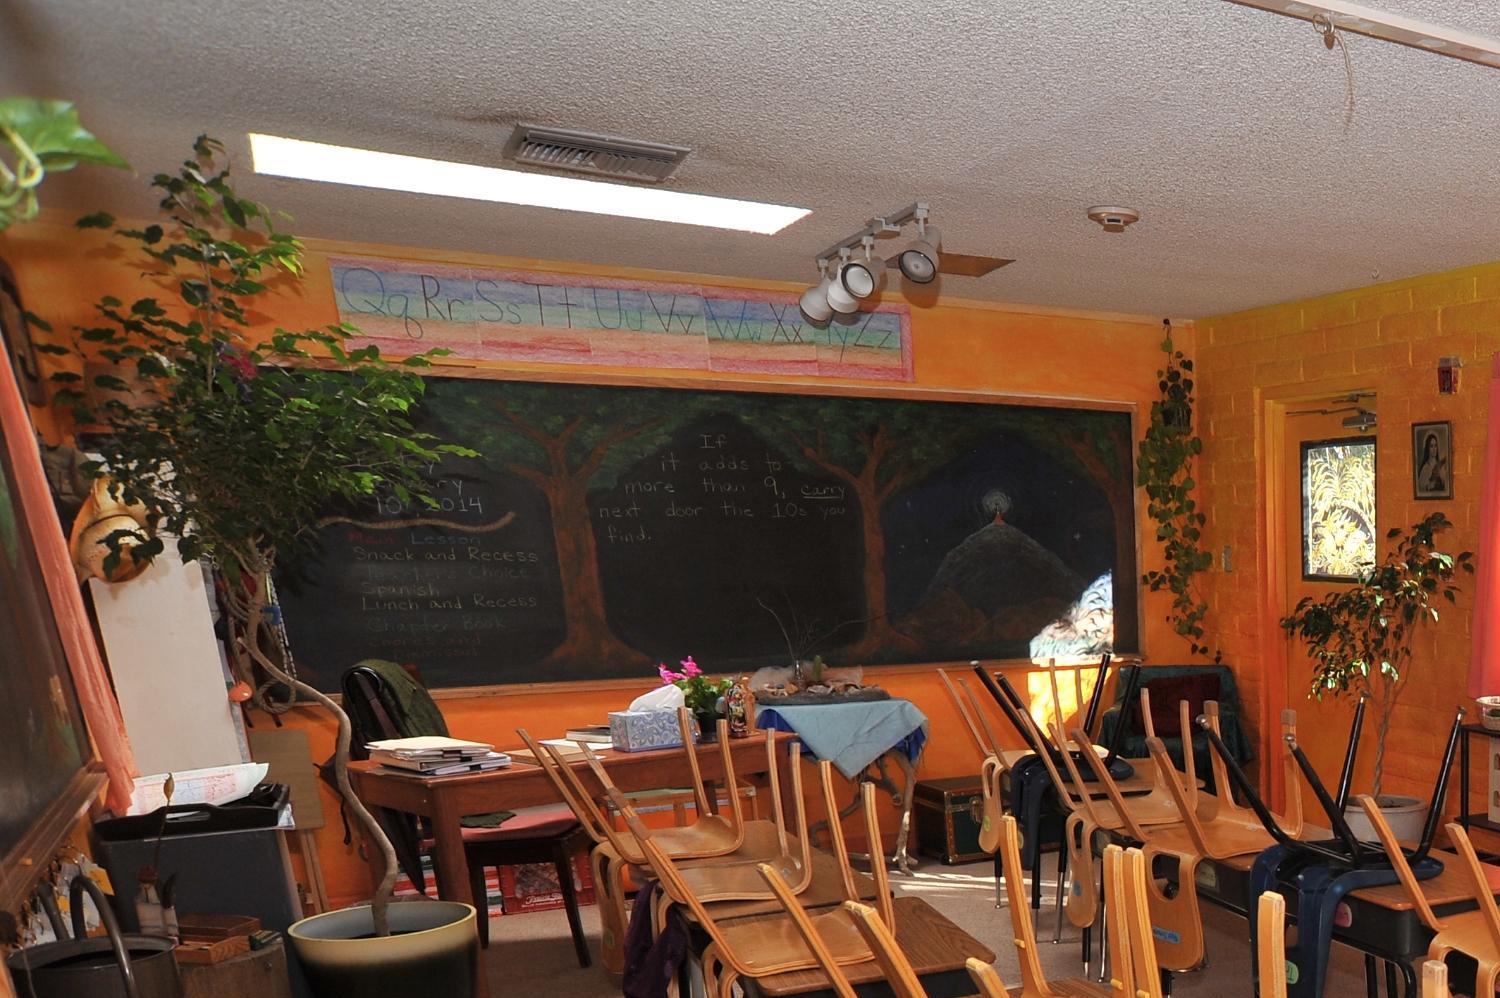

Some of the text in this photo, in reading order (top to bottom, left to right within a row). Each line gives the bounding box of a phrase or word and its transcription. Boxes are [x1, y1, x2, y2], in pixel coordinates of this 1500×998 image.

[699, 433, 729, 449] If
[661, 452, 784, 472] it adds to
[624, 482, 675, 495] more
[701, 477, 745, 493] than
[799, 484, 848, 499] carry
[599, 501, 846, 521] next door the 10s you
[352, 545, 539, 562] Snack and Recess
[361, 581, 440, 598] Spanish
[361, 592, 538, 611] Lunch and Recess
